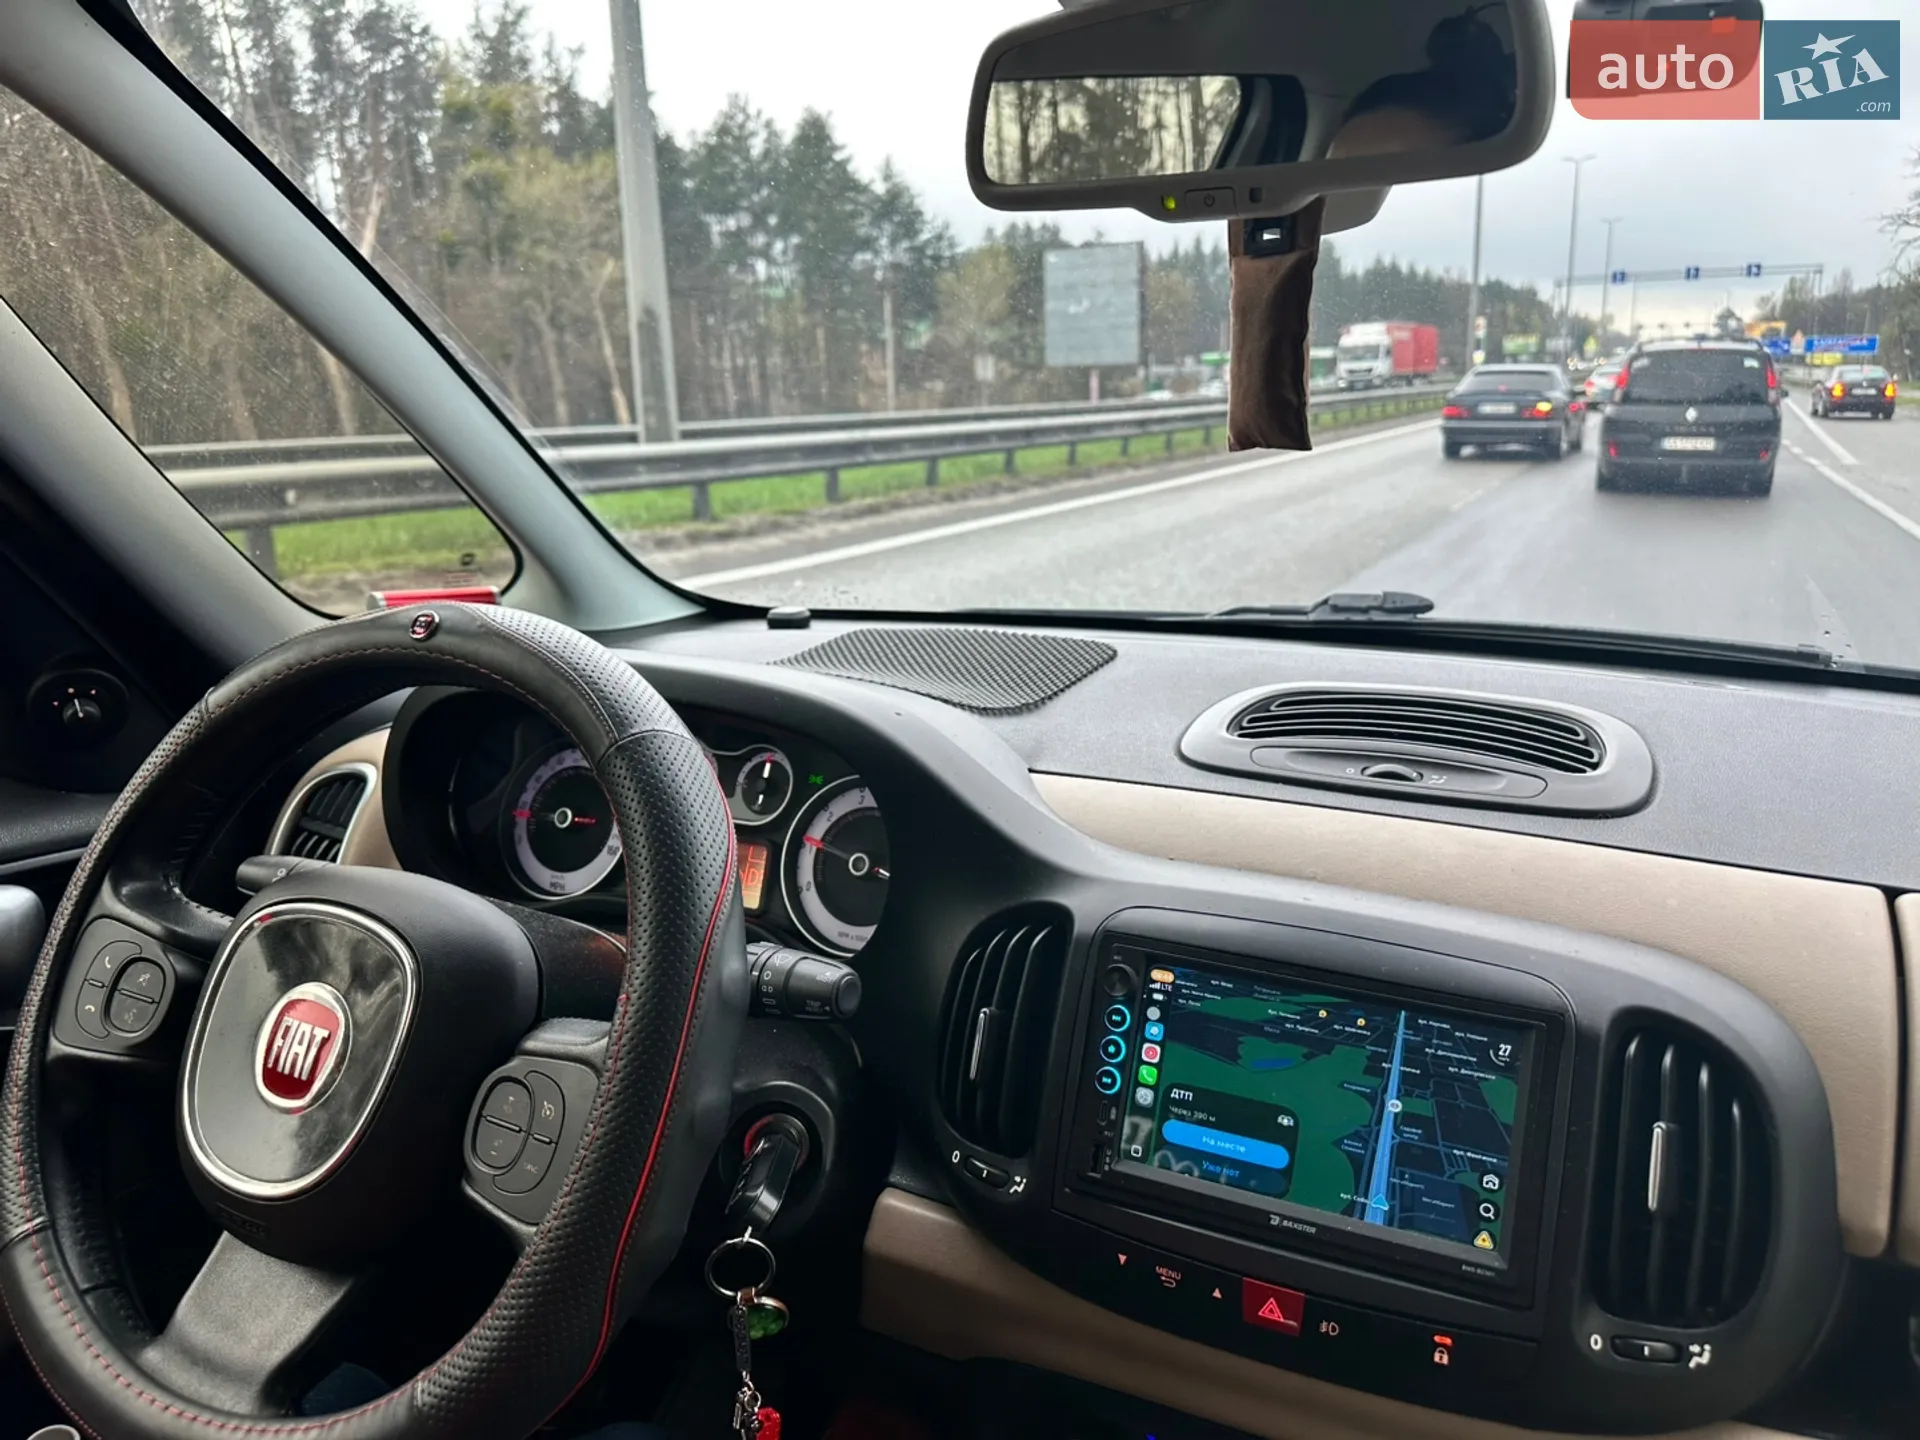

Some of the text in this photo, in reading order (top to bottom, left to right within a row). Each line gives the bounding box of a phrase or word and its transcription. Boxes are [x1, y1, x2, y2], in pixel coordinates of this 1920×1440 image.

[549, 882, 566, 891] MPH
[1161, 982, 1173, 991] LTE
[267, 1015, 330, 1081] FIAT
[1498, 1043, 1512, 1056] 27
[1170, 1088, 1193, 1102] ДТП
[1202, 1135, 1215, 1146] На
[1282, 1219, 1317, 1235] BAXSTER
[1155, 1265, 1182, 1281] MENU
